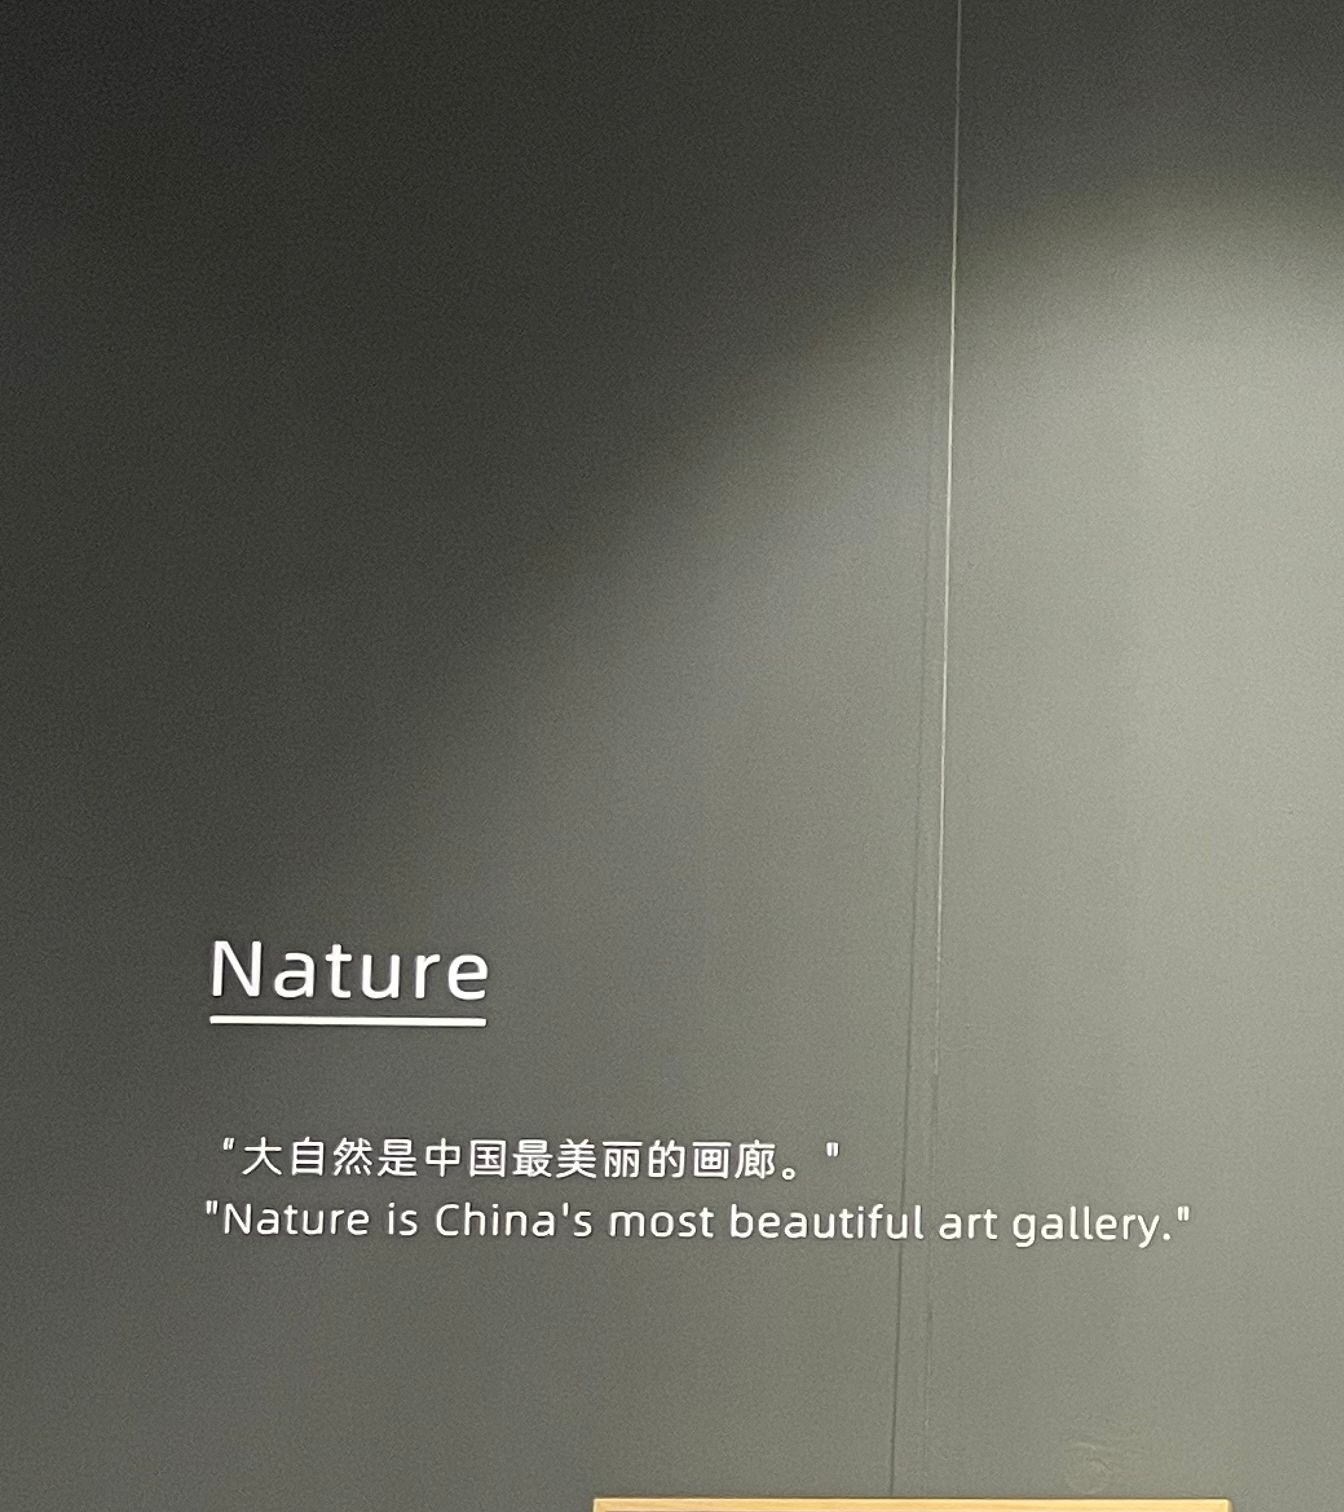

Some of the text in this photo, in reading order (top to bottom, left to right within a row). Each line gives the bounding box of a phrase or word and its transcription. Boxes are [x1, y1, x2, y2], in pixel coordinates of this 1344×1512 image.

[211, 940, 488, 1001] Nature
[205, 1199, 1190, 1249] "Nature is China's most beautiful art gallery."
